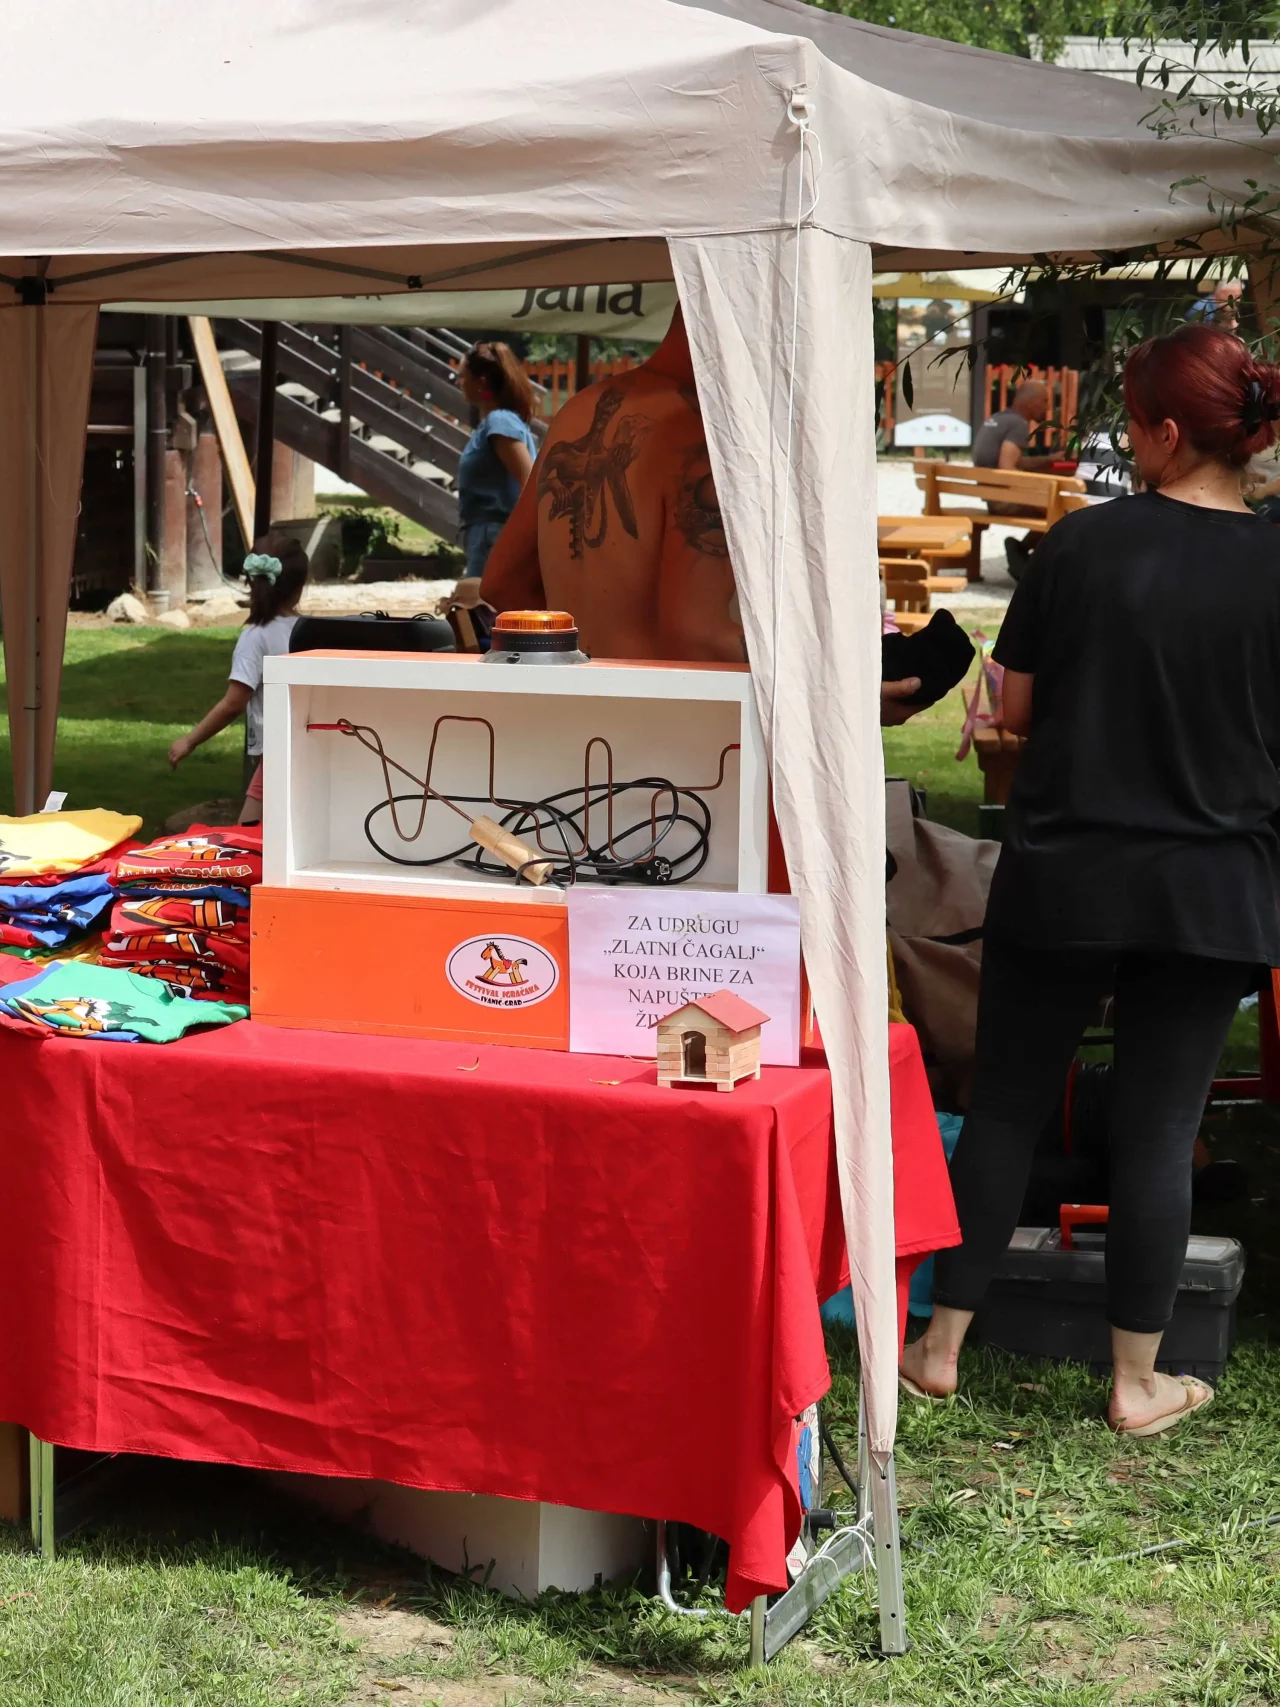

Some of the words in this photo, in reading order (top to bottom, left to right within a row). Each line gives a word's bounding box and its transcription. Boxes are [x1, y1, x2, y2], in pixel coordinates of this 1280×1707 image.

[627, 916, 653, 931] ZA
[658, 917, 740, 935] UDRUGU
[613, 963, 661, 980] KOJA
[667, 966, 724, 983] BRINE
[729, 969, 754, 985] ZA
[465, 980, 500, 998] FESTIVAL
